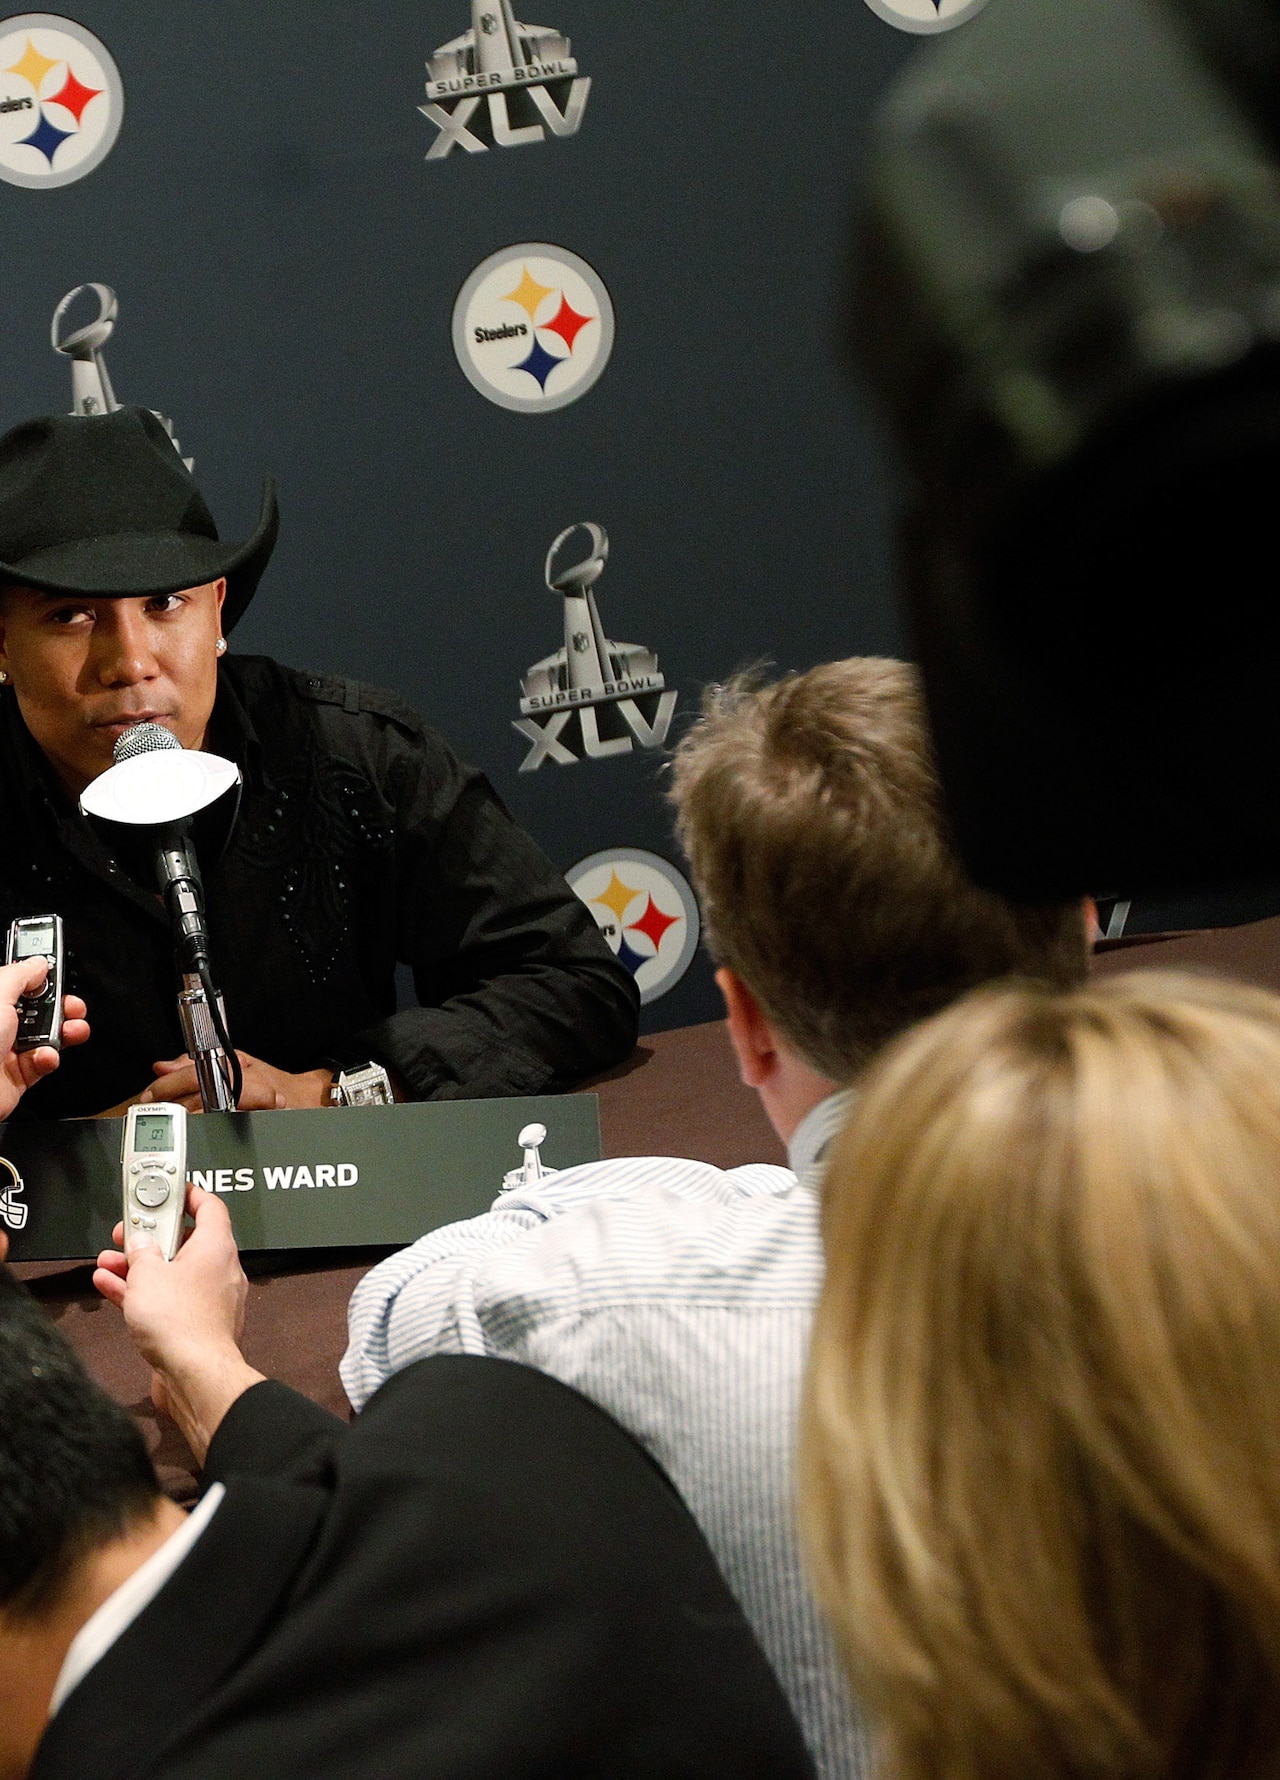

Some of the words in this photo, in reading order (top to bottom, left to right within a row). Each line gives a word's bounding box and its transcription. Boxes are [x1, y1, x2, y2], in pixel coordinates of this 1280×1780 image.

[437, 73, 501, 94] SUPER
[513, 60, 569, 81] BOWL
[417, 76, 593, 161] XLV
[474, 322, 528, 343] Steelers
[529, 688, 593, 710] SUPER
[604, 676, 657, 696] BOWL
[511, 690, 678, 772] XLV
[187, 1168, 255, 1193] NES
[263, 1163, 359, 1190] WARD
